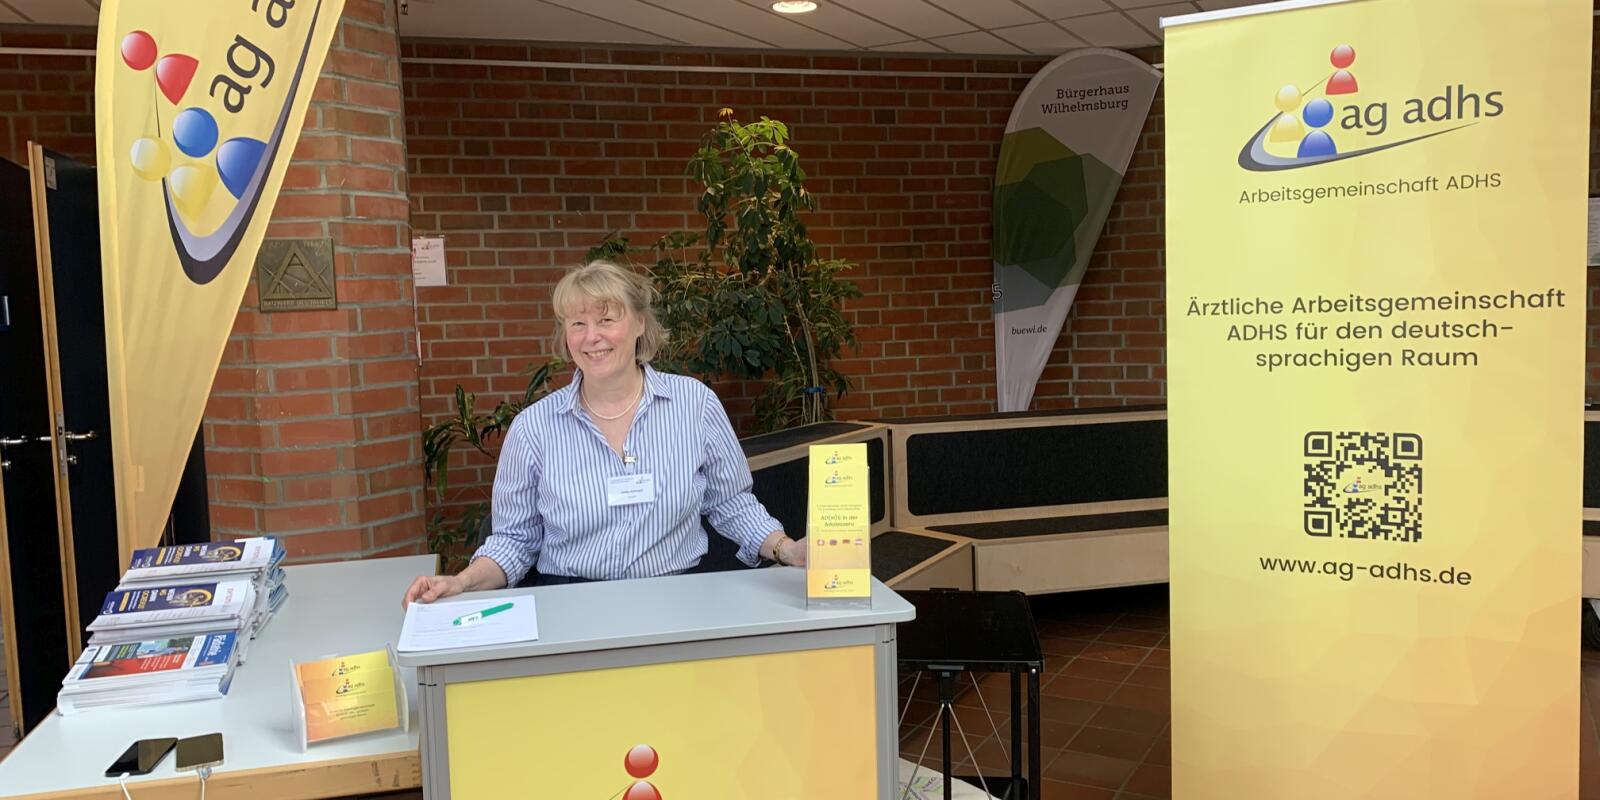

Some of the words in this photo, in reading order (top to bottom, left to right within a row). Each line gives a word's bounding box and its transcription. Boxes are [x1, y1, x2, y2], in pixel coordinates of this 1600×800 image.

[209, 34, 276, 113] ag
[1041, 98, 1129, 115] Wilhelmsburg
[1056, 84, 1130, 102] Bürgerhaus
[1339, 103, 1388, 136] ag
[1402, 83, 1505, 124] adhs
[1239, 176, 1439, 205] Arbeitsgemeinschaft
[1445, 172, 1502, 192] ADHS
[1186, 296, 1284, 316] Ärztliche
[1291, 288, 1566, 317] Arbeitsgemeinschaft
[1011, 324, 1048, 336] buewi.de
[1226, 323, 1288, 341] ADHS
[1295, 322, 1329, 340] für
[1335, 321, 1383, 340] den
[1390, 318, 1514, 339] deutsch-
[1255, 347, 1393, 373] sprachigen
[1401, 347, 1479, 367] Raum
[1259, 556, 1472, 586] www.ag-adhs.de
